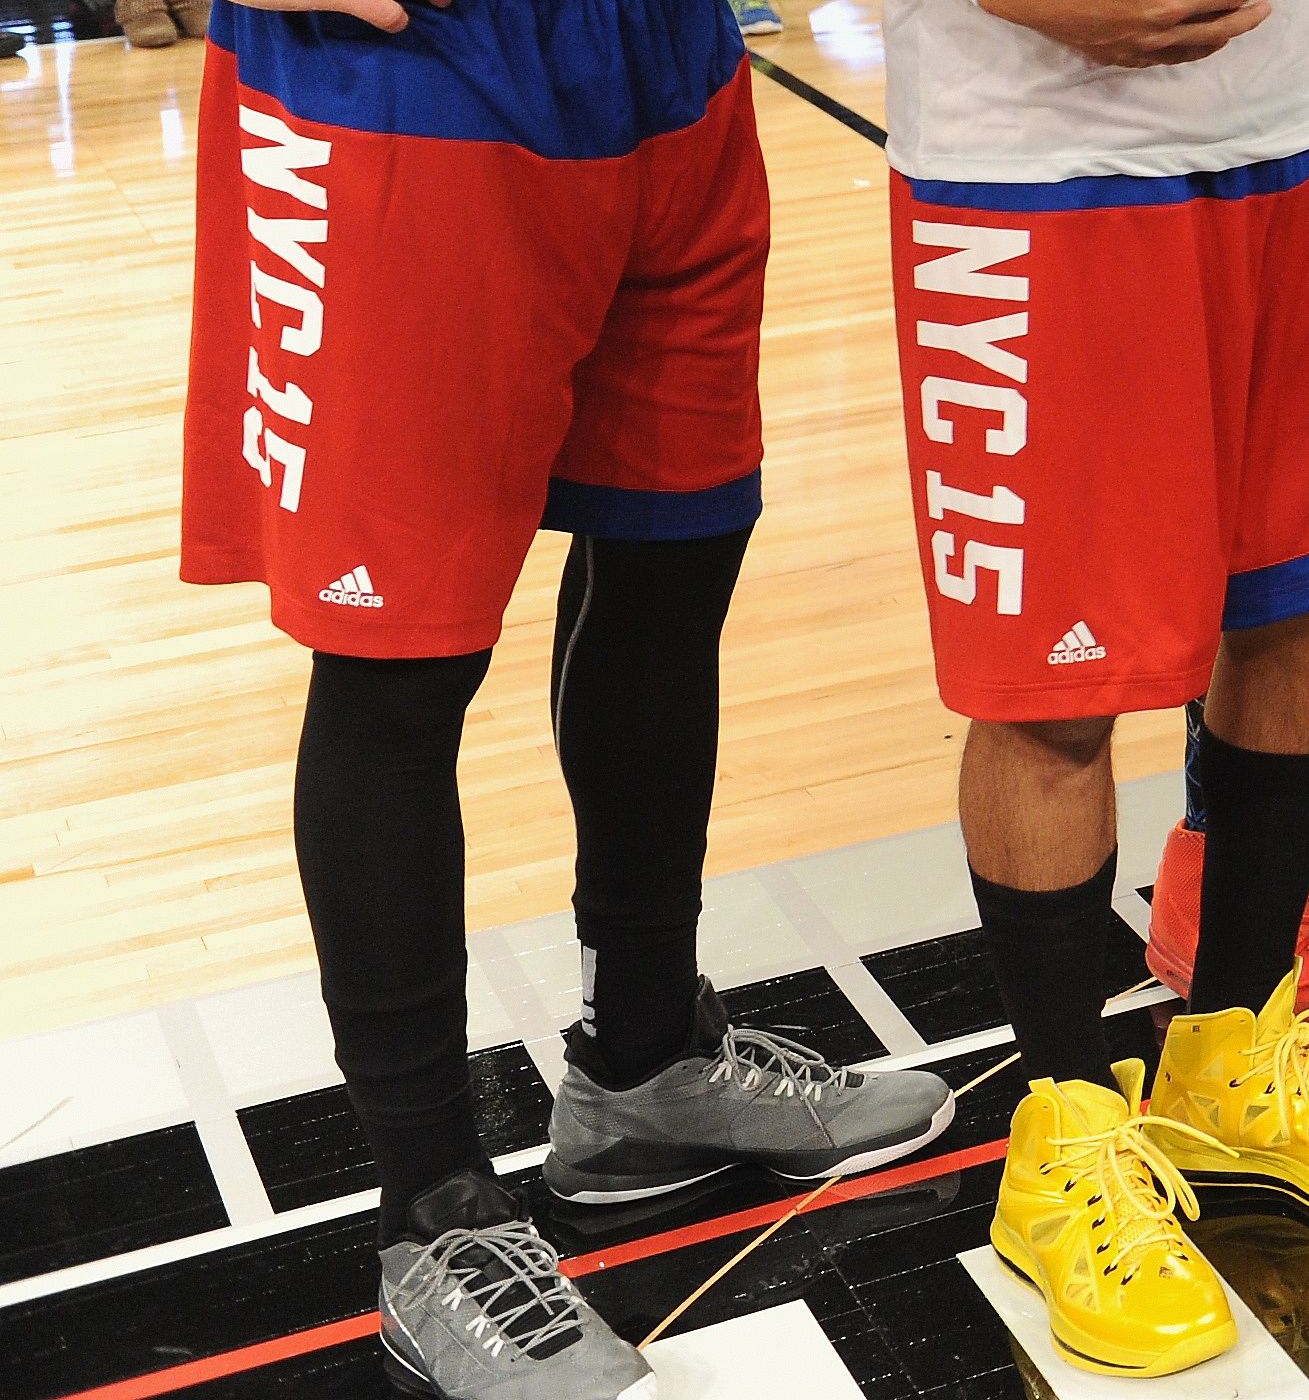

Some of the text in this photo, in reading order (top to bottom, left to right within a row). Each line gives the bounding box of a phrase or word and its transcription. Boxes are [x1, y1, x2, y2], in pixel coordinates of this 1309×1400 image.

[239, 103, 333, 514] NYC 15
[912, 219, 1031, 616] NYC 15
[318, 587, 384, 610] adidas
[1047, 643, 1107, 666] adidas
